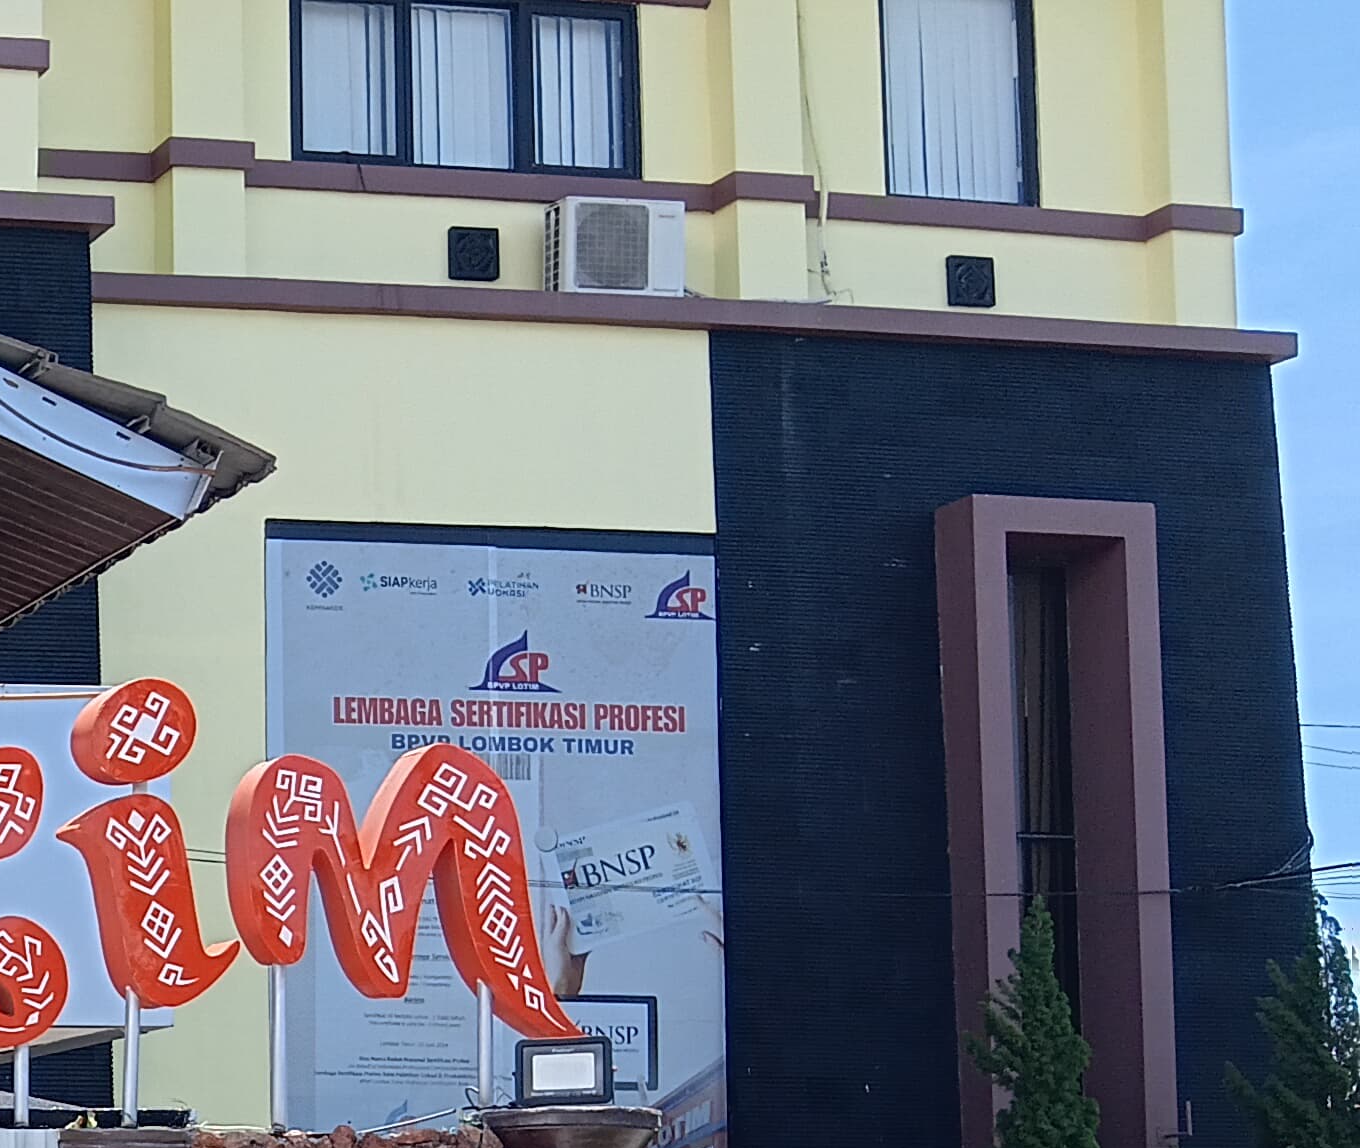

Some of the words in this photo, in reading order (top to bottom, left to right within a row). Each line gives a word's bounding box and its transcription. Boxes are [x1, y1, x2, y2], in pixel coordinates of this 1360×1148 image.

[380, 576, 437, 591] SIAPkerja
[590, 584, 632, 599] BNSP
[333, 697, 442, 727] LEMBAGA
[451, 700, 586, 731] SERTIFIKASI
[594, 703, 686, 733] PROFESI
[459, 735, 555, 753] LOMBOK
[562, 738, 635, 755] TIMUR
[581, 844, 656, 888] BNSP
